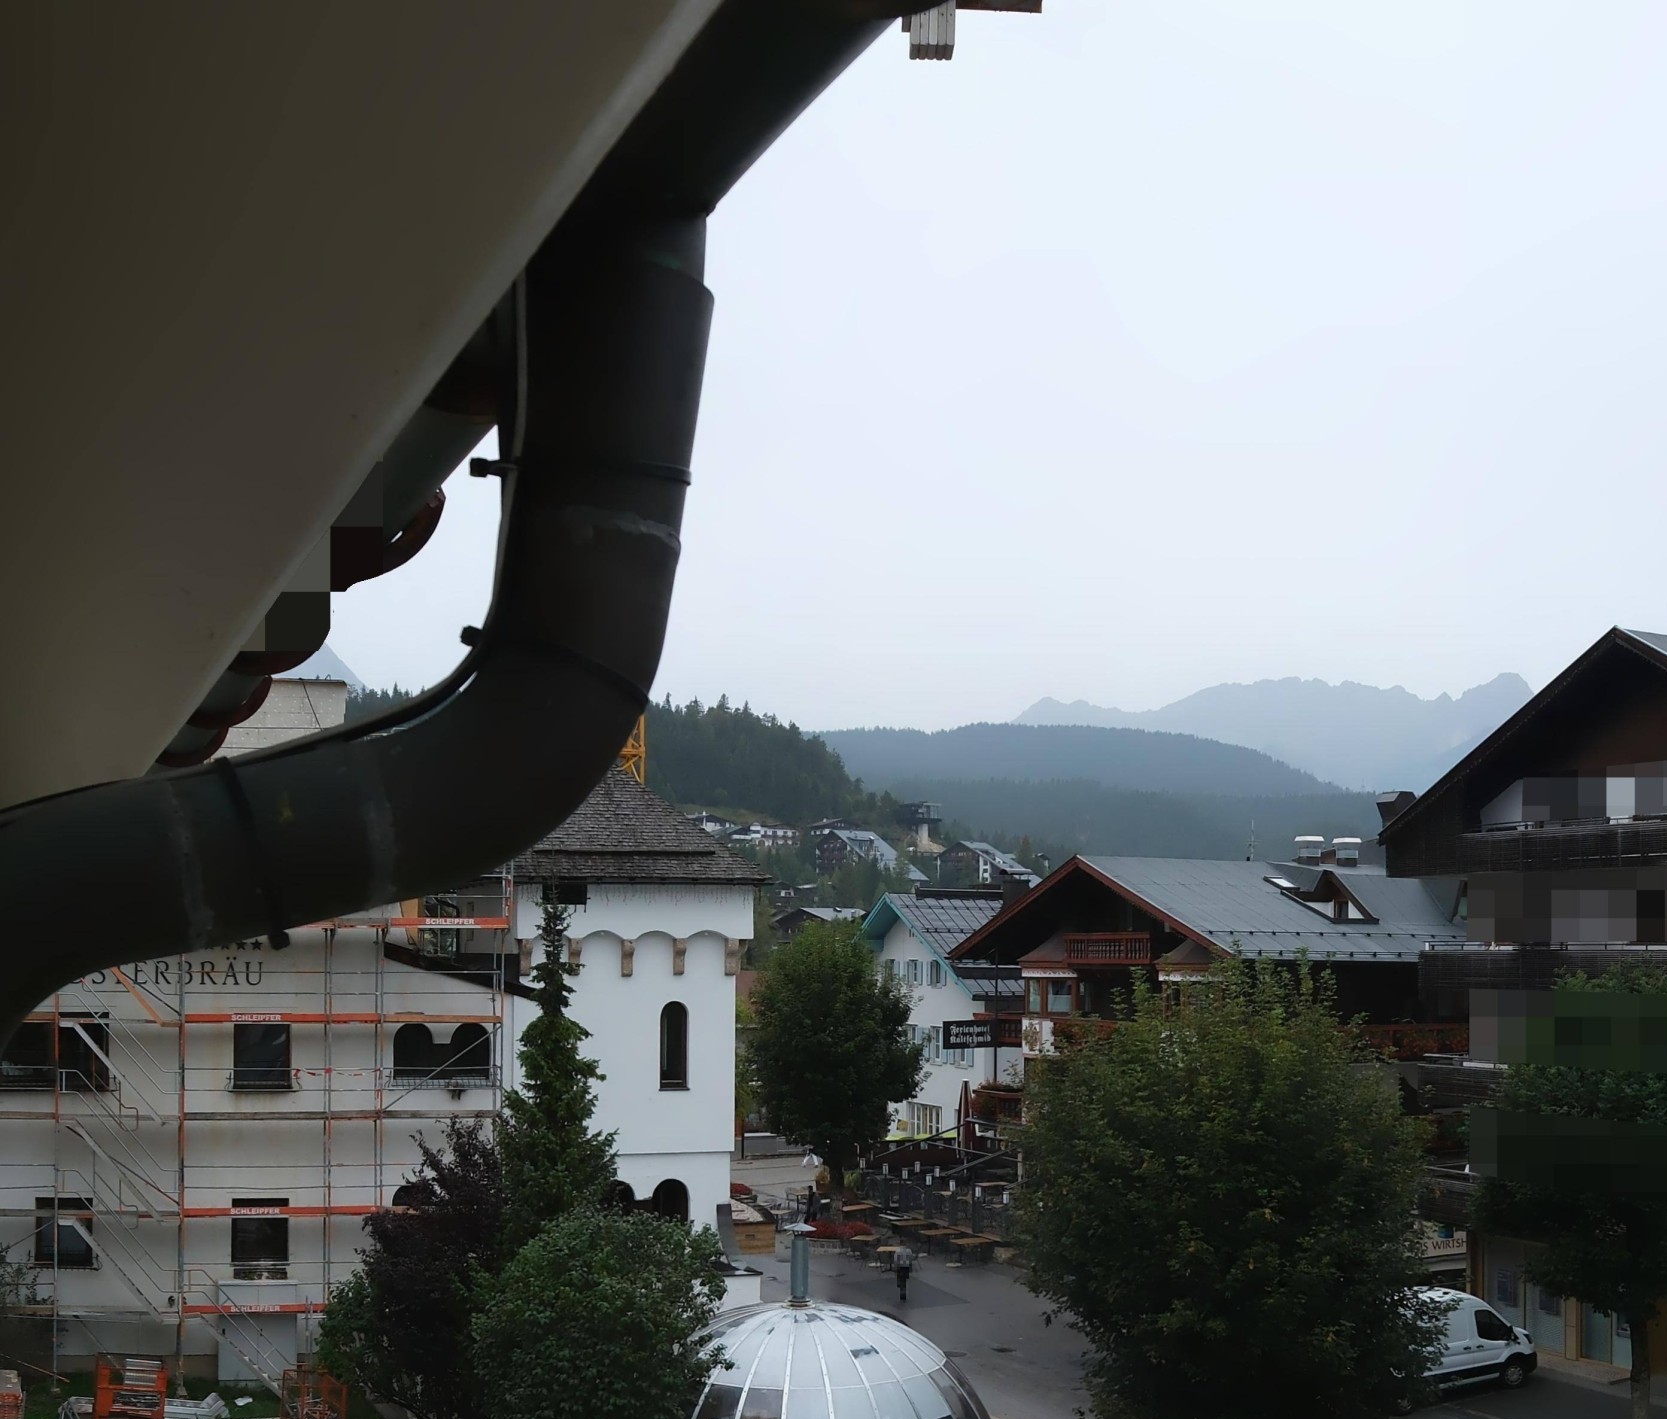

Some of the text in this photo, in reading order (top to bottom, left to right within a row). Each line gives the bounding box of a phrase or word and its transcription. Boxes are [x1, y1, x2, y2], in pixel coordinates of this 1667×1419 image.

[425, 918, 475, 926] SCHLEIPFER
[231, 1013, 282, 1022] SCHLEIPFER
[230, 1207, 280, 1215] SCHLEIPFER
[230, 1304, 281, 1312] SCHLEIPFER
